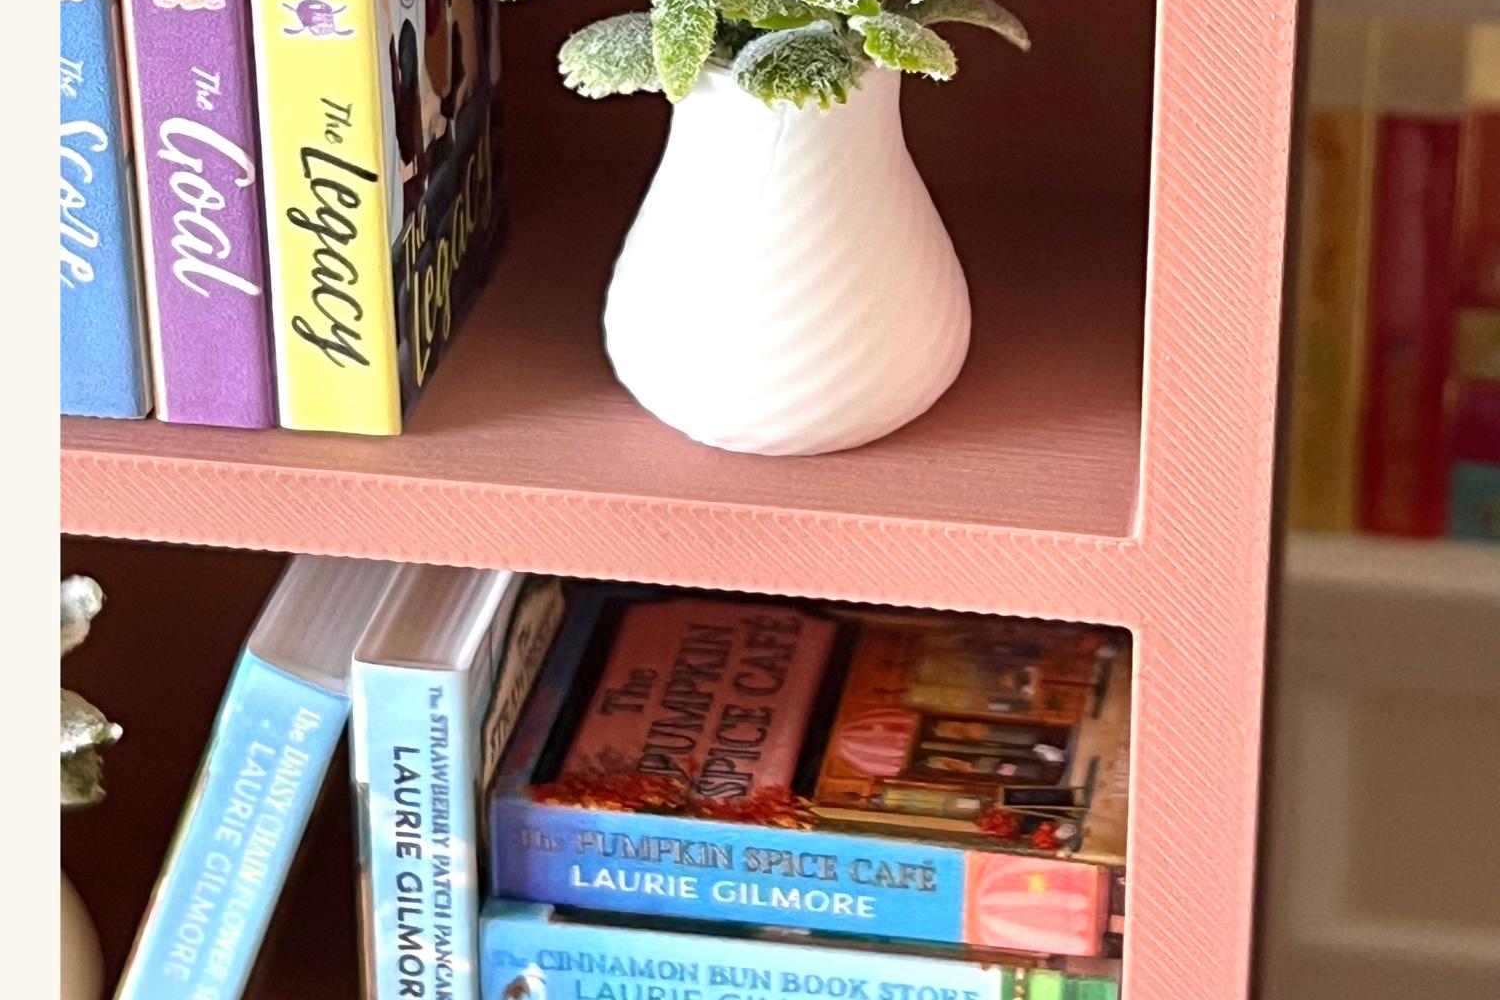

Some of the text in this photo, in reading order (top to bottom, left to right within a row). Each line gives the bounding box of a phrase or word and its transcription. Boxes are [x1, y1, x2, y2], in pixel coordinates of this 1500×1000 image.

[157, 66, 261, 298] The Goal
[285, 97, 378, 367] The Legacy
[403, 204, 428, 290] The
[413, 103, 493, 388] Legacy
[429, 686, 443, 710] The
[216, 741, 276, 847] LAURIE
[264, 745, 309, 813] DAISY
[430, 713, 450, 848] STRAWBERRY
[696, 704, 773, 798] SPICE
[393, 745, 422, 860] LAURIE
[238, 814, 283, 884] CHAIN
[432, 854, 452, 918] PATCH
[571, 865, 876, 917] LAURIE GILMORE
[576, 830, 734, 870] PUMPKIN
[744, 847, 839, 881] SPICE
[850, 858, 937, 892] CAFÉ
[163, 852, 231, 982] GILMORE
[536, 950, 699, 983] CINNAMON
[708, 965, 771, 991] BUN
[780, 971, 870, 1000] BOOK
